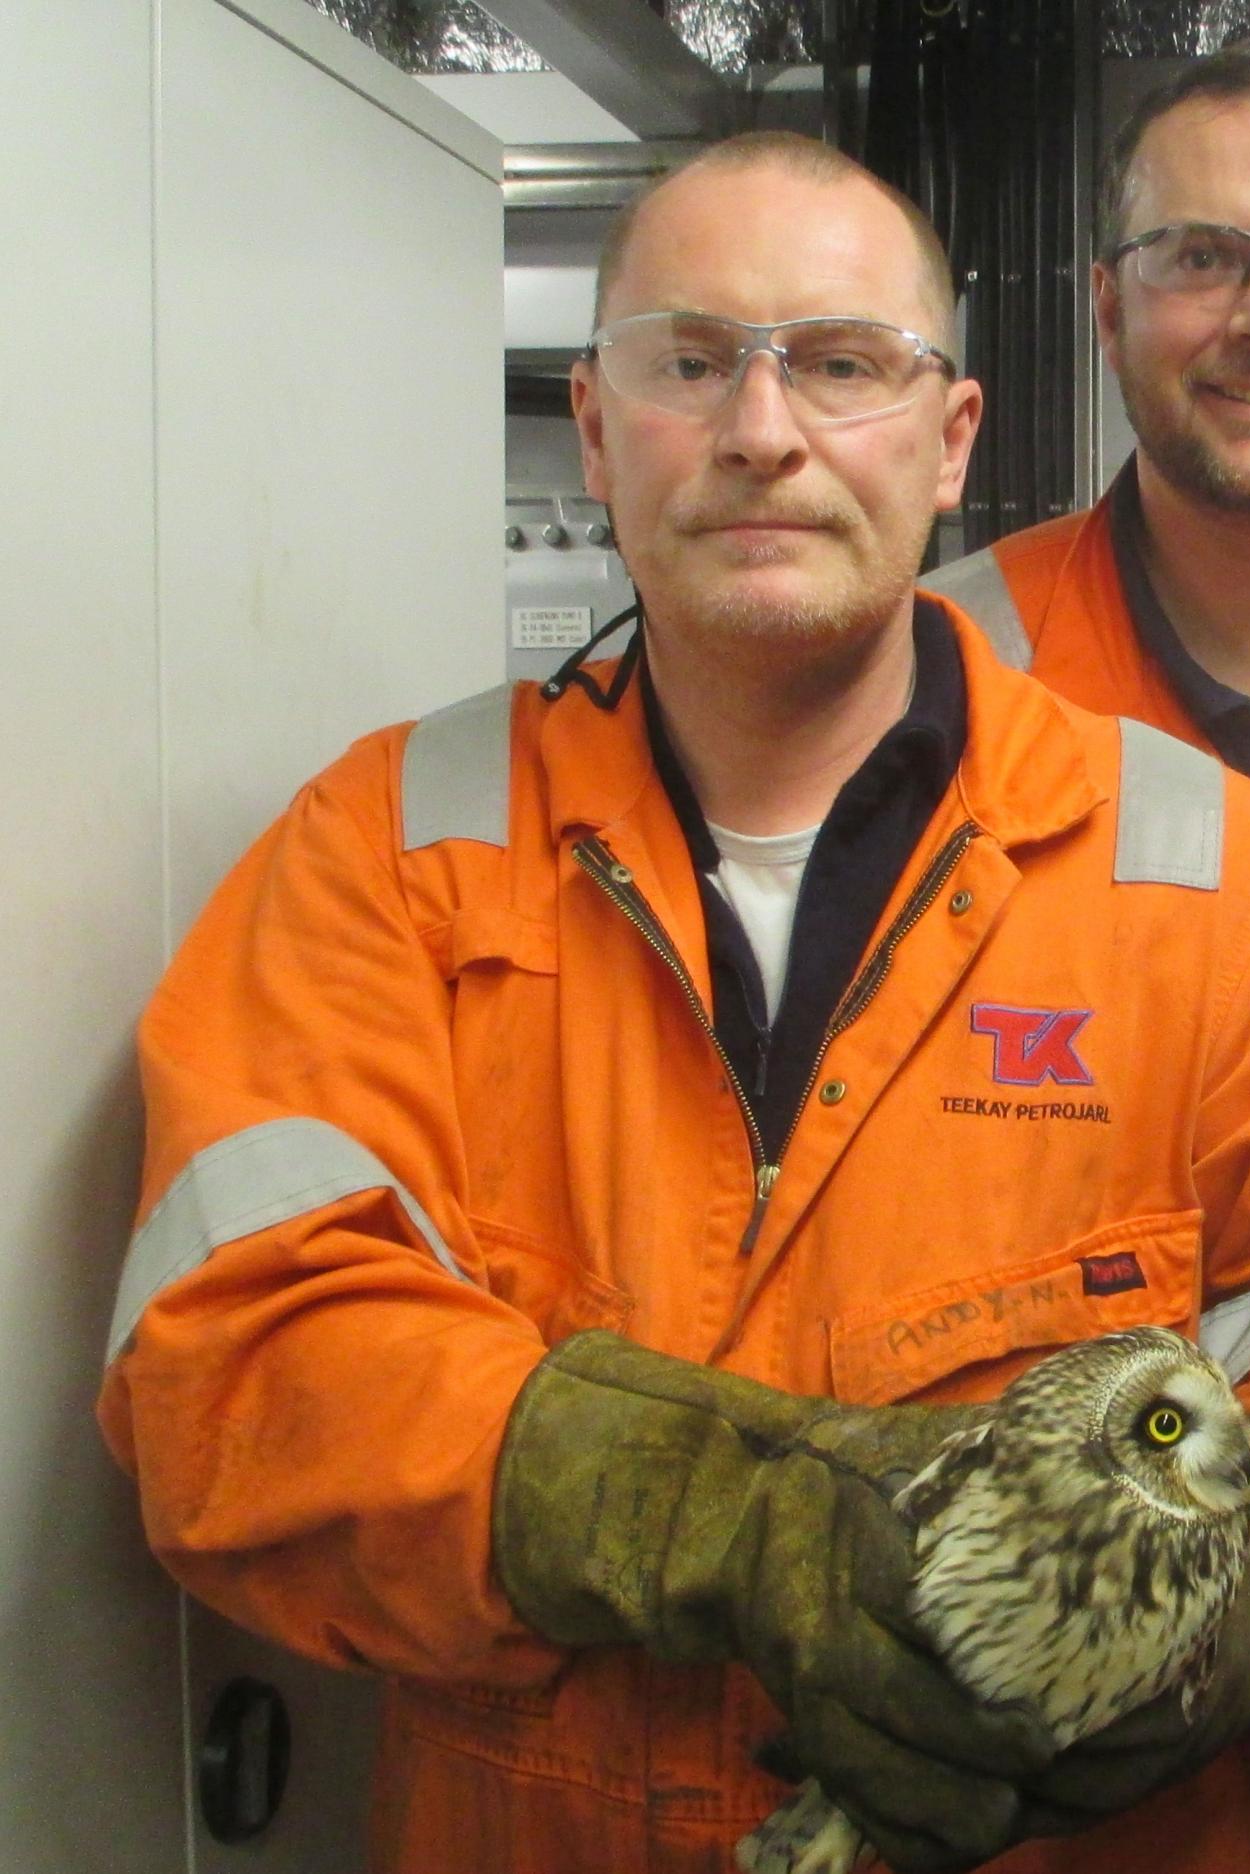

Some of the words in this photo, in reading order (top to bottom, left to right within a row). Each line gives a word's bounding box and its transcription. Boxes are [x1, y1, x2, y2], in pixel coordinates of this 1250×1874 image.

[970, 1002, 1094, 1086] TK
[940, 1096, 1012, 1118] TEEKAY
[1016, 1100, 1113, 1124] PETROJARL
